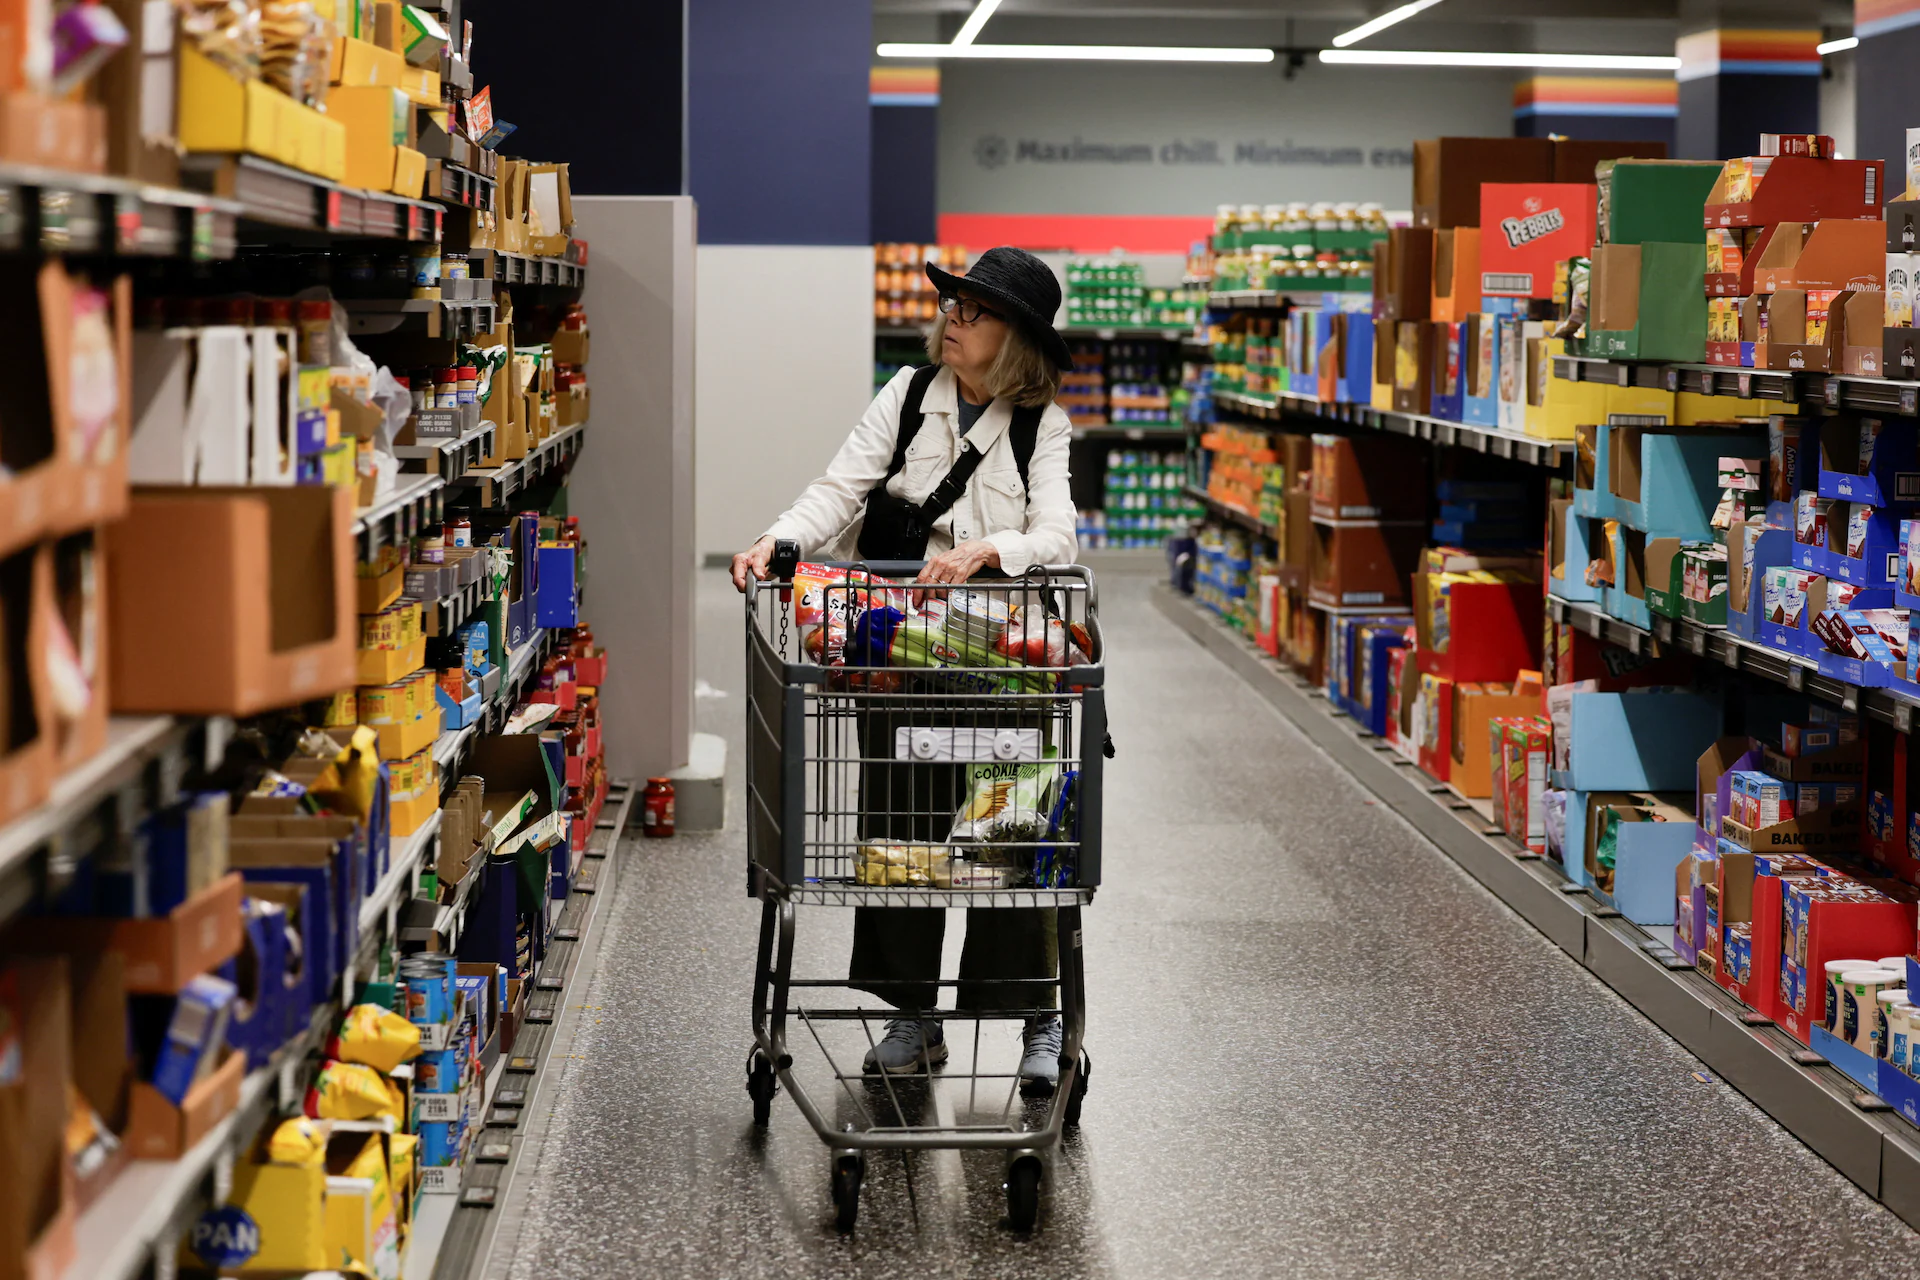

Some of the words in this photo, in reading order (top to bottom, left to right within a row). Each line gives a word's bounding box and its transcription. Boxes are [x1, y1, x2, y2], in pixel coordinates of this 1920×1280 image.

[1016, 137, 1153, 165] Maximum
[1159, 137, 1225, 166] chill.
[1235, 138, 1365, 167] Minimum
[1501, 208, 1564, 249] PEBBLES
[1845, 282, 1882, 292] Millville
[1888, 269, 1908, 289] PROTEIN
[1786, 446, 1797, 487] Chewy
[975, 762, 1021, 780] COOKIE
[1771, 832, 1826, 845] BAKED
